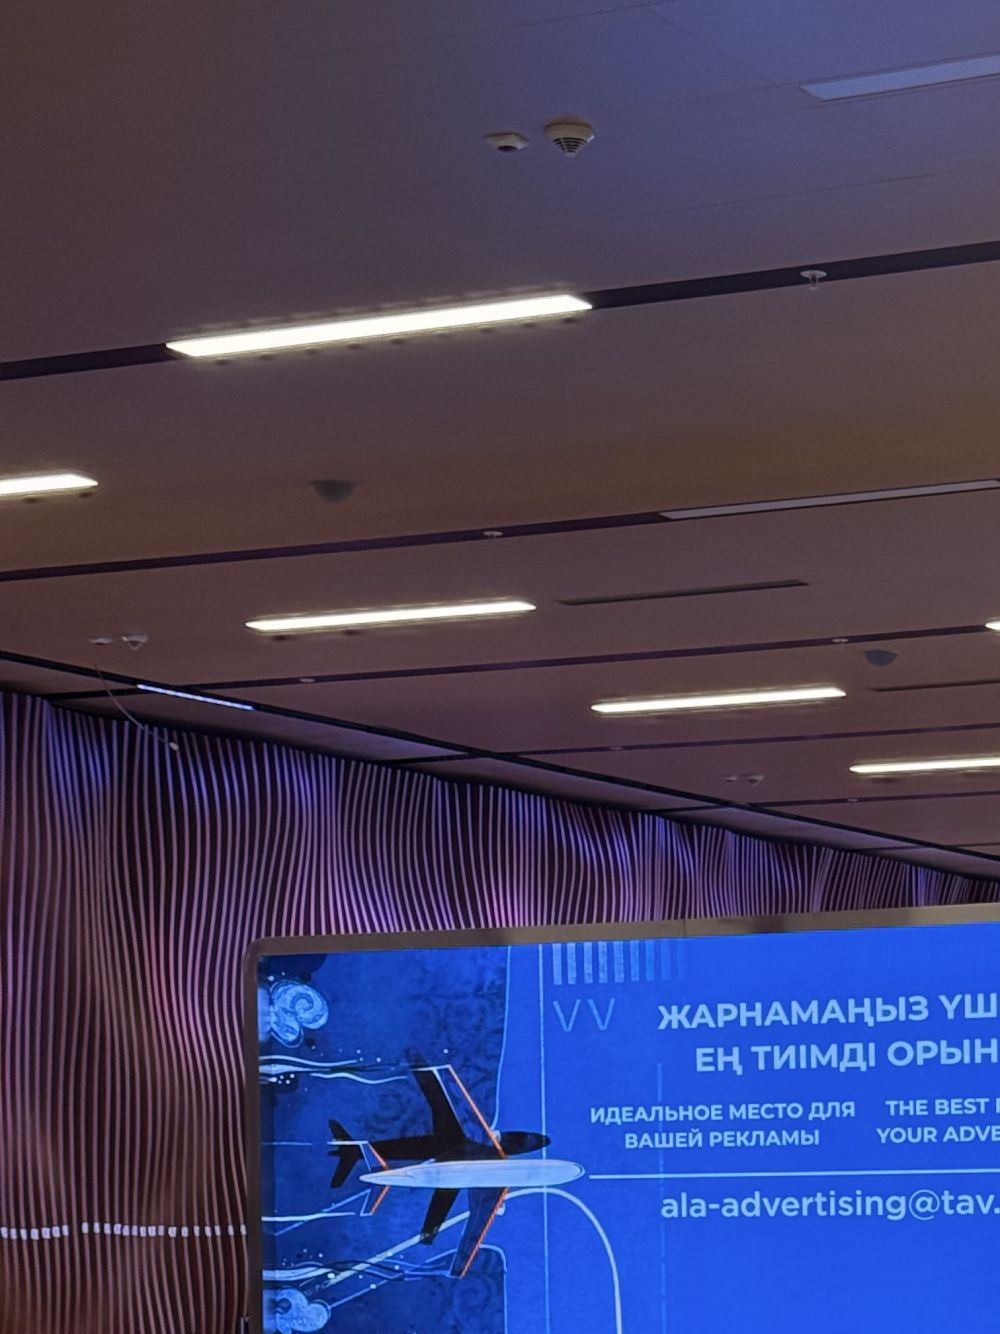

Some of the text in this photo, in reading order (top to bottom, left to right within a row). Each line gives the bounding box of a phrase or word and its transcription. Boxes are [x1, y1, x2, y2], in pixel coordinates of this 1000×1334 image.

[658, 995, 929, 1030] ЖАРНАМАҢЫЗ
[695, 1037, 999, 1076] ЕҢ ТИІМДІ ОРЫН
[590, 1101, 856, 1126] ИДЕАЛЬНОЕ МЕСТО ДЛЯ
[885, 1099, 929, 1116] THE
[934, 1097, 990, 1115] BEST
[624, 1128, 820, 1149] ВАШЕЙ РЕКЛАМЫ
[876, 1126, 938, 1144] YOUR
